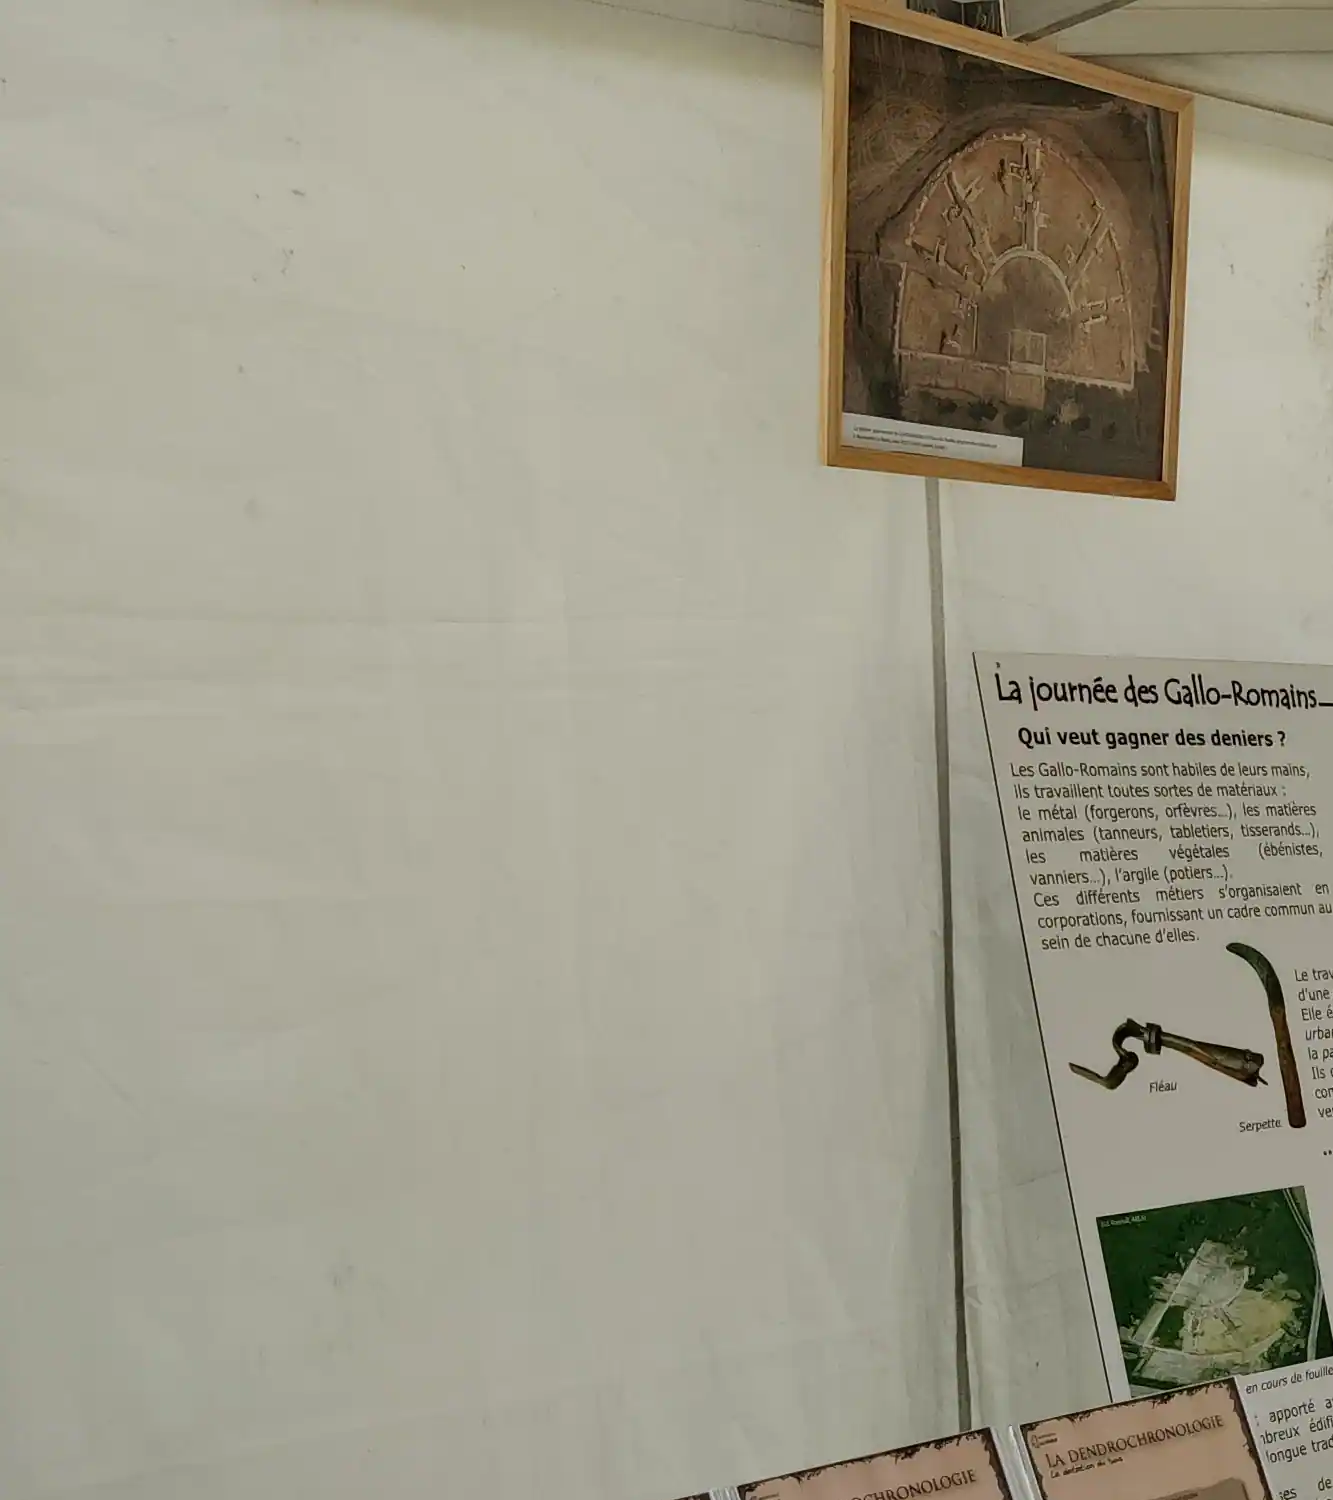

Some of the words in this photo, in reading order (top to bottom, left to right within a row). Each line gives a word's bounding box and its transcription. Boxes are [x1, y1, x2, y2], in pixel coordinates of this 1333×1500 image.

[994, 672, 1023, 705] La
[1028, 675, 1119, 711] journée
[1123, 674, 1159, 708] des
[1163, 676, 1321, 710] Gallo-Romains
[1017, 726, 1052, 750] Qui
[1056, 728, 1102, 746] veut
[1105, 732, 1170, 750] gagner
[1174, 728, 1206, 746] des
[1210, 728, 1274, 747] deniers
[1010, 762, 1035, 778] Les
[1038, 761, 1138, 777] Gallo-Romains
[1140, 763, 1170, 777] sont
[1171, 761, 1217, 777] habiles
[1219, 762, 1236, 777] de
[1237, 762, 1269, 777] leurs
[1270, 763, 1310, 779] mains,
